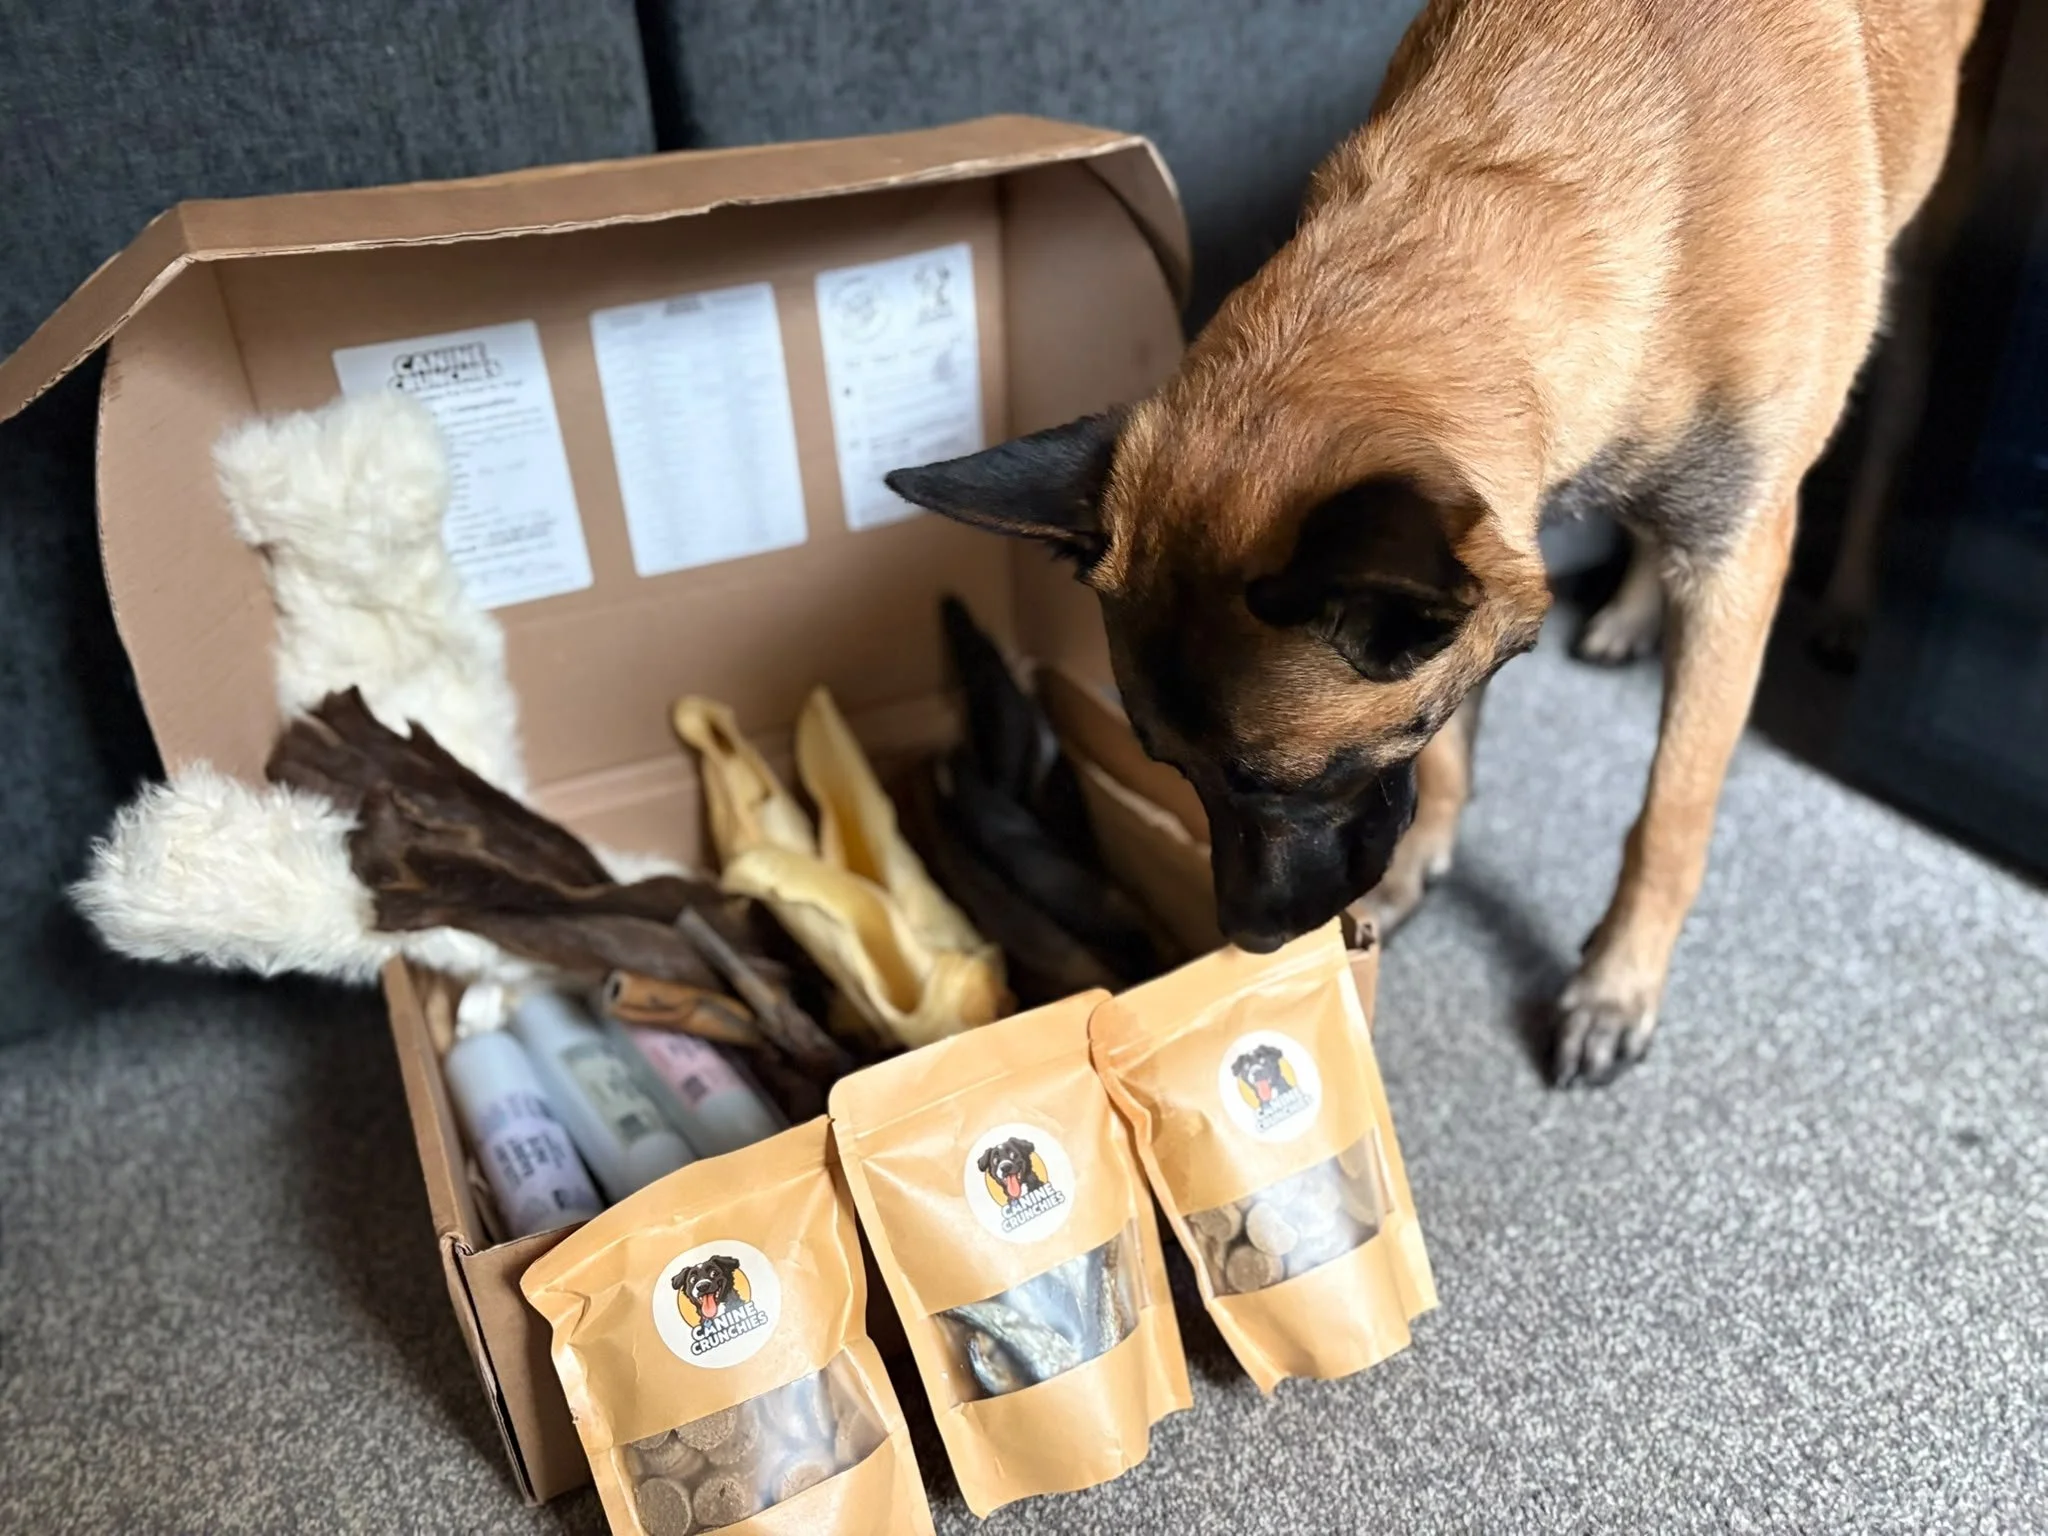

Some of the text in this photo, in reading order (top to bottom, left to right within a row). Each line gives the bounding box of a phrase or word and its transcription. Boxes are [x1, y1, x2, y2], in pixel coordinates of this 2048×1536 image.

[1001, 1182, 1056, 1219] CANINE
[1001, 1191, 1065, 1232] CRUNCHIES
[690, 1311, 768, 1356] CRUNCHIES
[691, 1301, 757, 1340] CANINE
